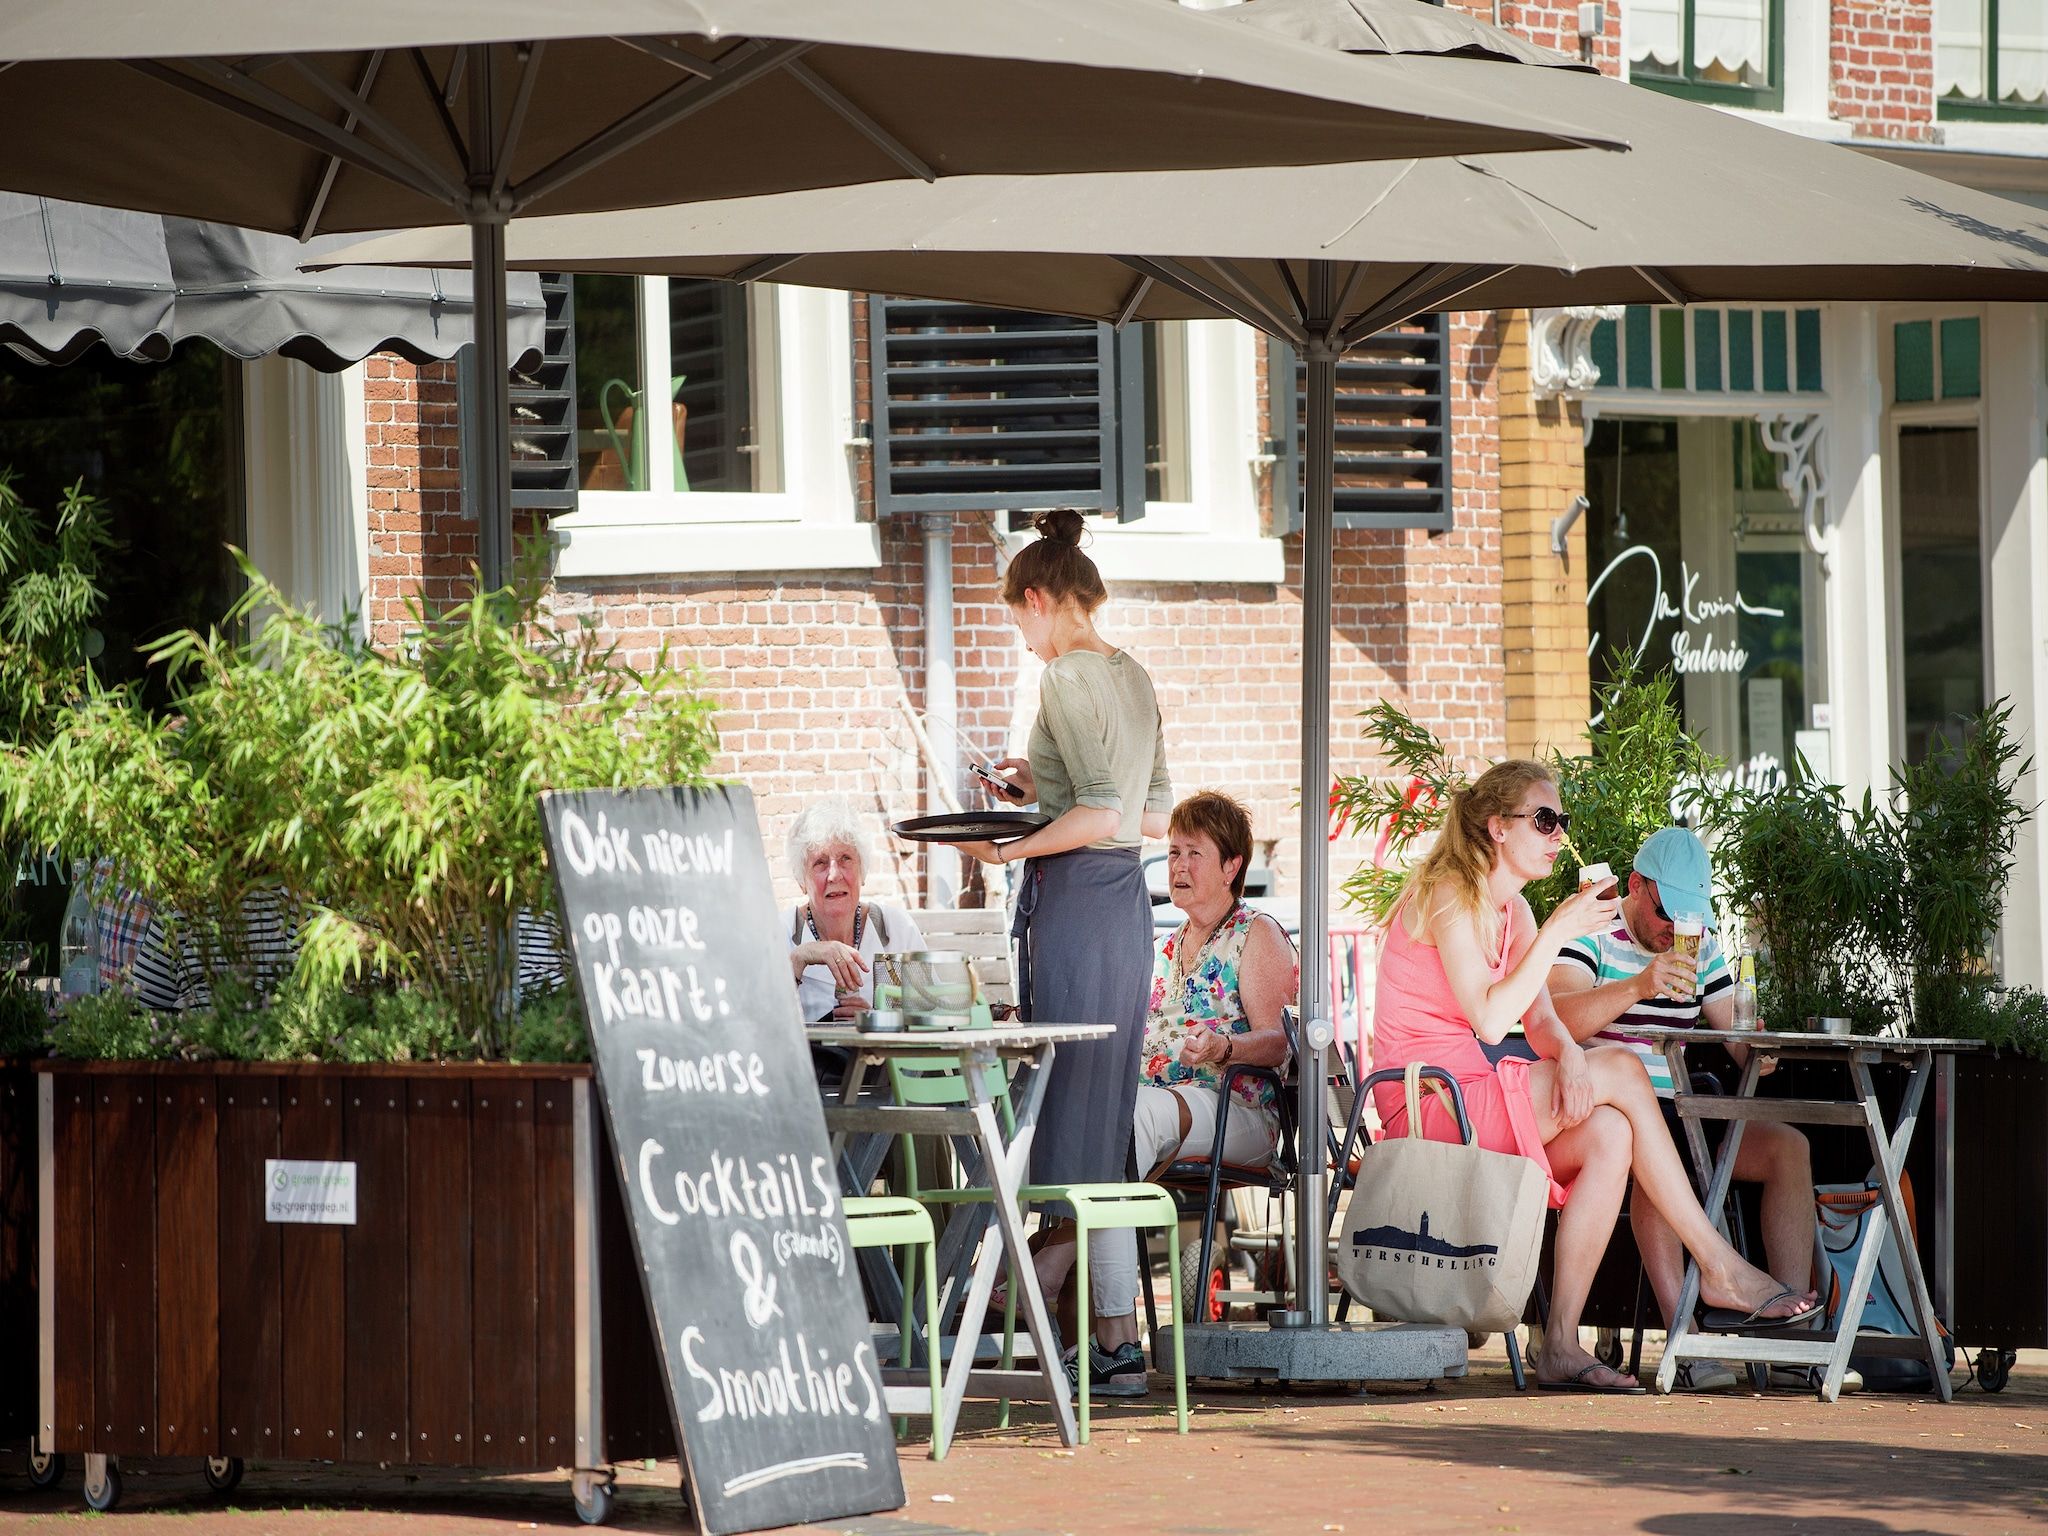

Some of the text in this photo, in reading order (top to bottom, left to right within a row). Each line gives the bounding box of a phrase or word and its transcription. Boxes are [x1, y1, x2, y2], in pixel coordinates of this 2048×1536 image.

[1671, 630, 1748, 673] Galerie
[641, 828, 734, 875] nieuw
[583, 904, 706, 969] op onze
[638, 1137, 836, 1226] Cocktails
[729, 1229, 784, 1330] &
[1352, 1248, 1497, 1271] TERSCHELLING
[680, 1325, 881, 1423] Smoothies
